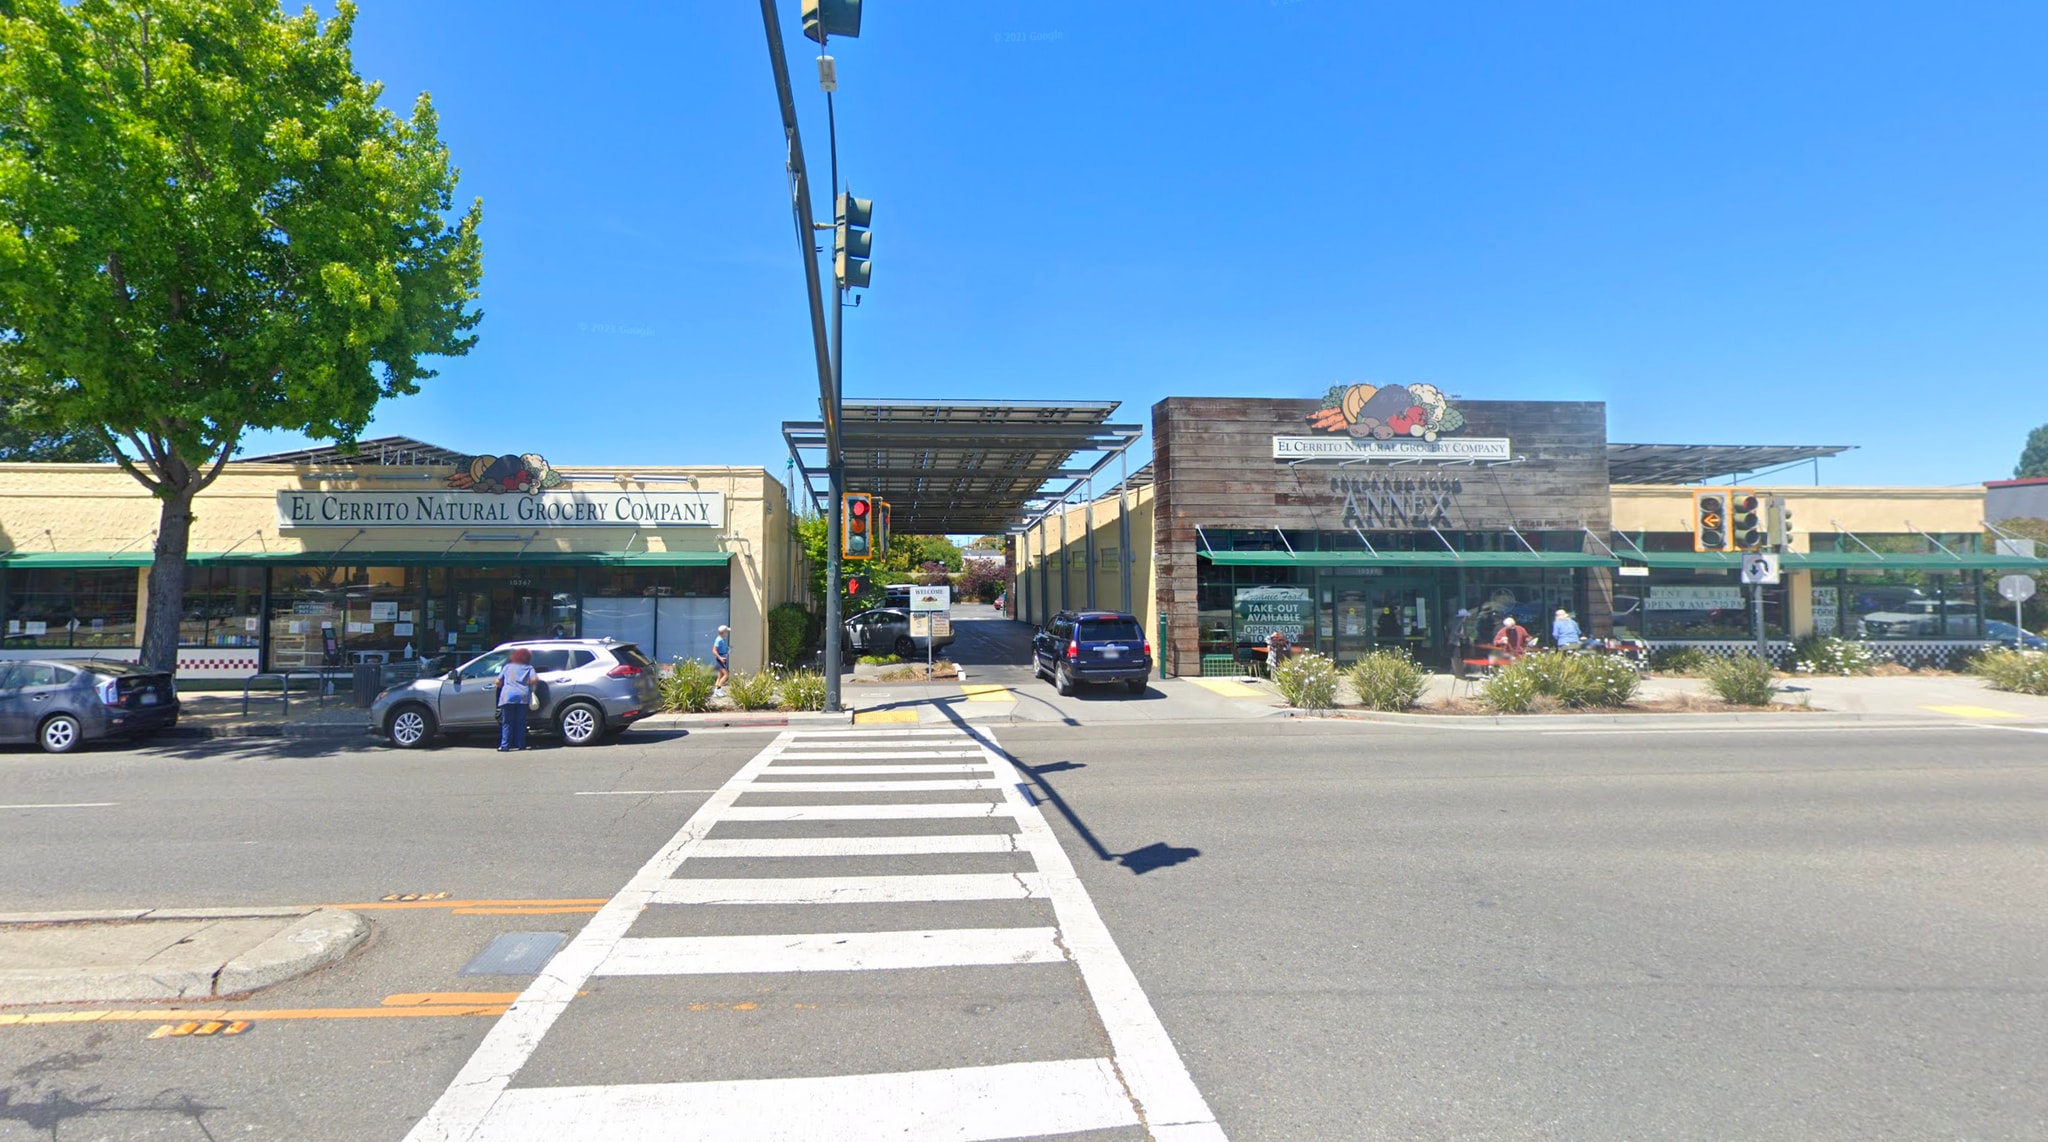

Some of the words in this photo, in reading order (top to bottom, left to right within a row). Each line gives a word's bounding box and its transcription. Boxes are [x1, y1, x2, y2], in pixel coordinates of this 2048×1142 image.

[1278, 441, 1292, 452] EL
[1294, 441, 1342, 452] CERRITO
[1344, 441, 1398, 453] NATURAL
[1452, 442, 1506, 453] COMPANY
[1341, 489, 1448, 516] ANNEX
[291, 496, 314, 521] EL
[321, 496, 409, 521] CERRITO
[416, 496, 510, 521] NATURAL
[518, 496, 609, 521] GROCERY
[615, 496, 710, 521] COMPANY
[1247, 604, 1299, 613] TAKE-OUT
[1247, 613, 1301, 622] AVAILABLE
[1245, 625, 1270, 634] OPEN
